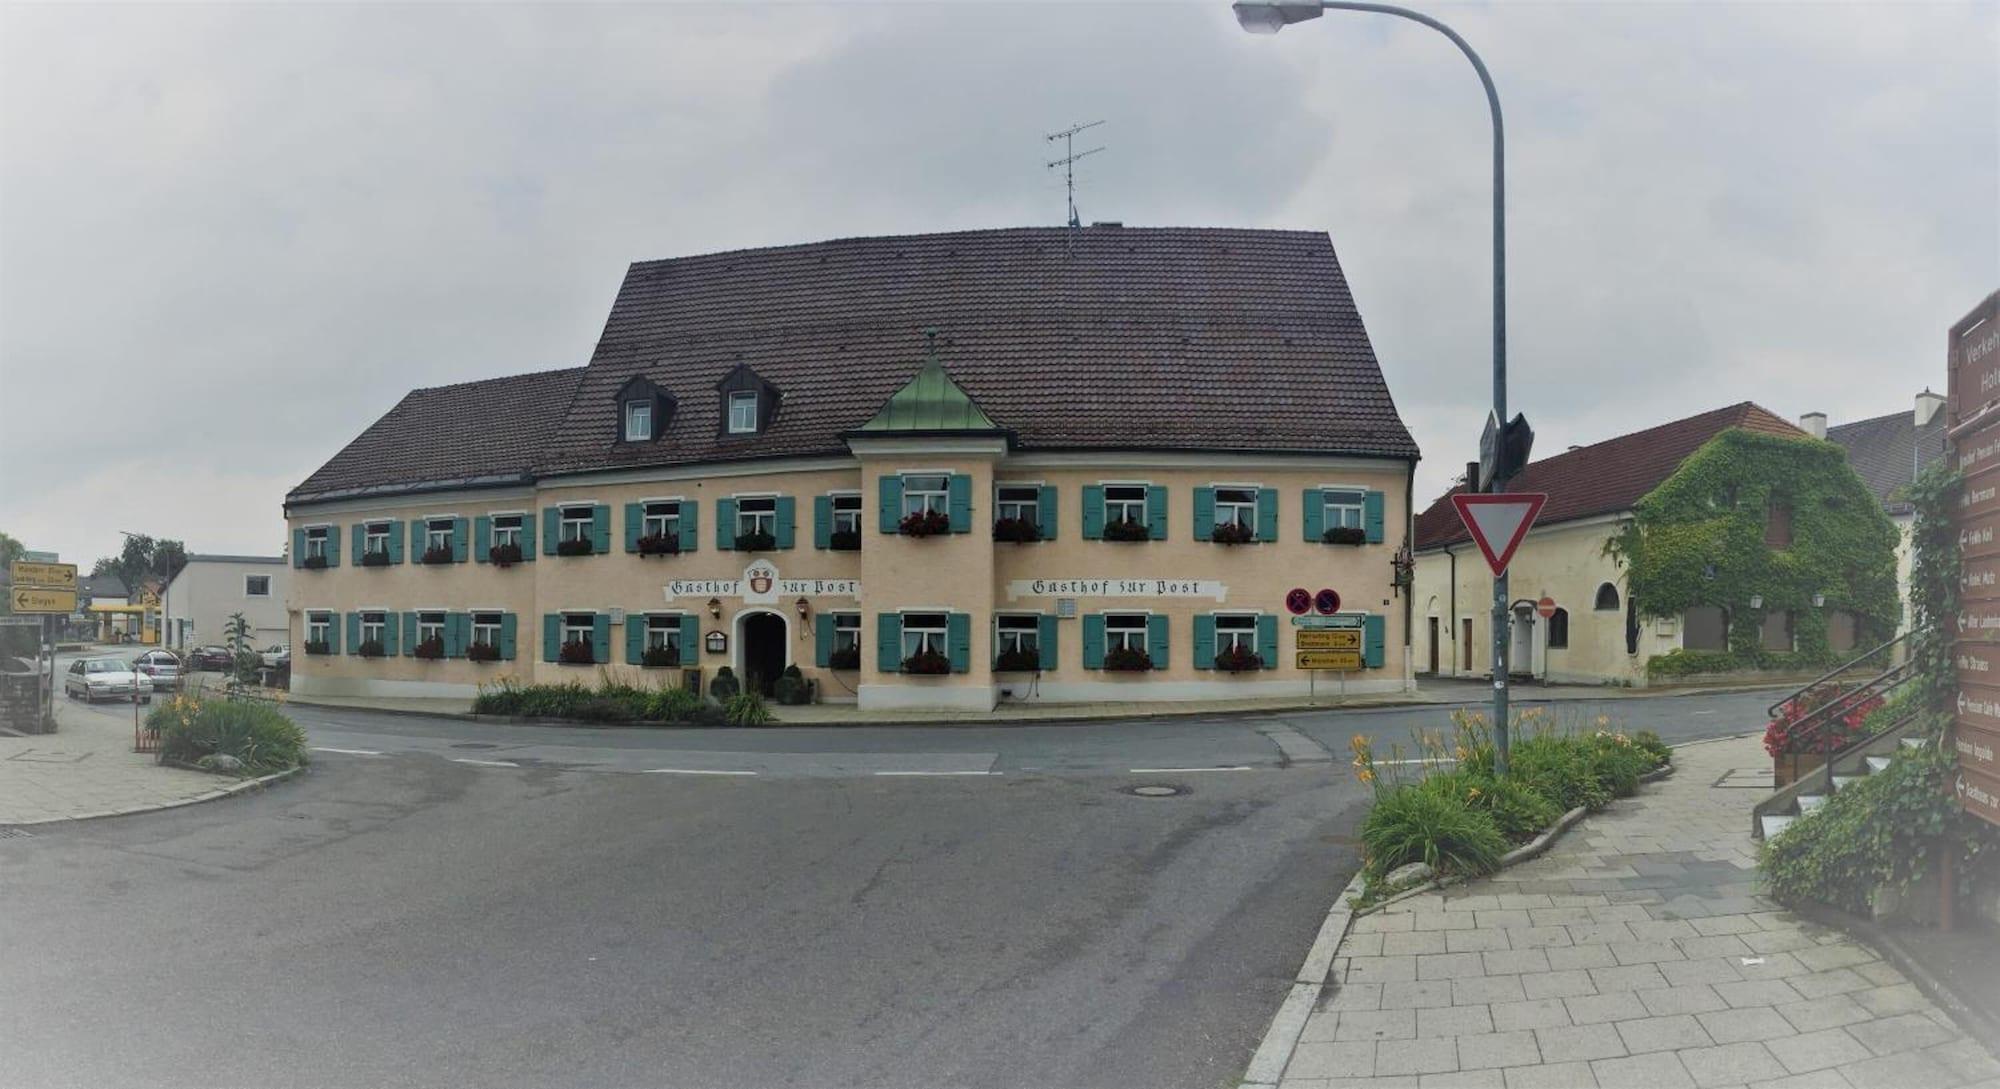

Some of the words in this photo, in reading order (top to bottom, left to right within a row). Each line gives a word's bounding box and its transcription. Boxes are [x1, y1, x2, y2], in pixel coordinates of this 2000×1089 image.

[671, 580, 739, 595] Gasthof
[783, 582, 807, 594] zur
[814, 580, 855, 595] Post
[1031, 580, 1109, 595] Gasthof
[1119, 581, 1147, 595] zur
[1156, 580, 1200, 595] Post
